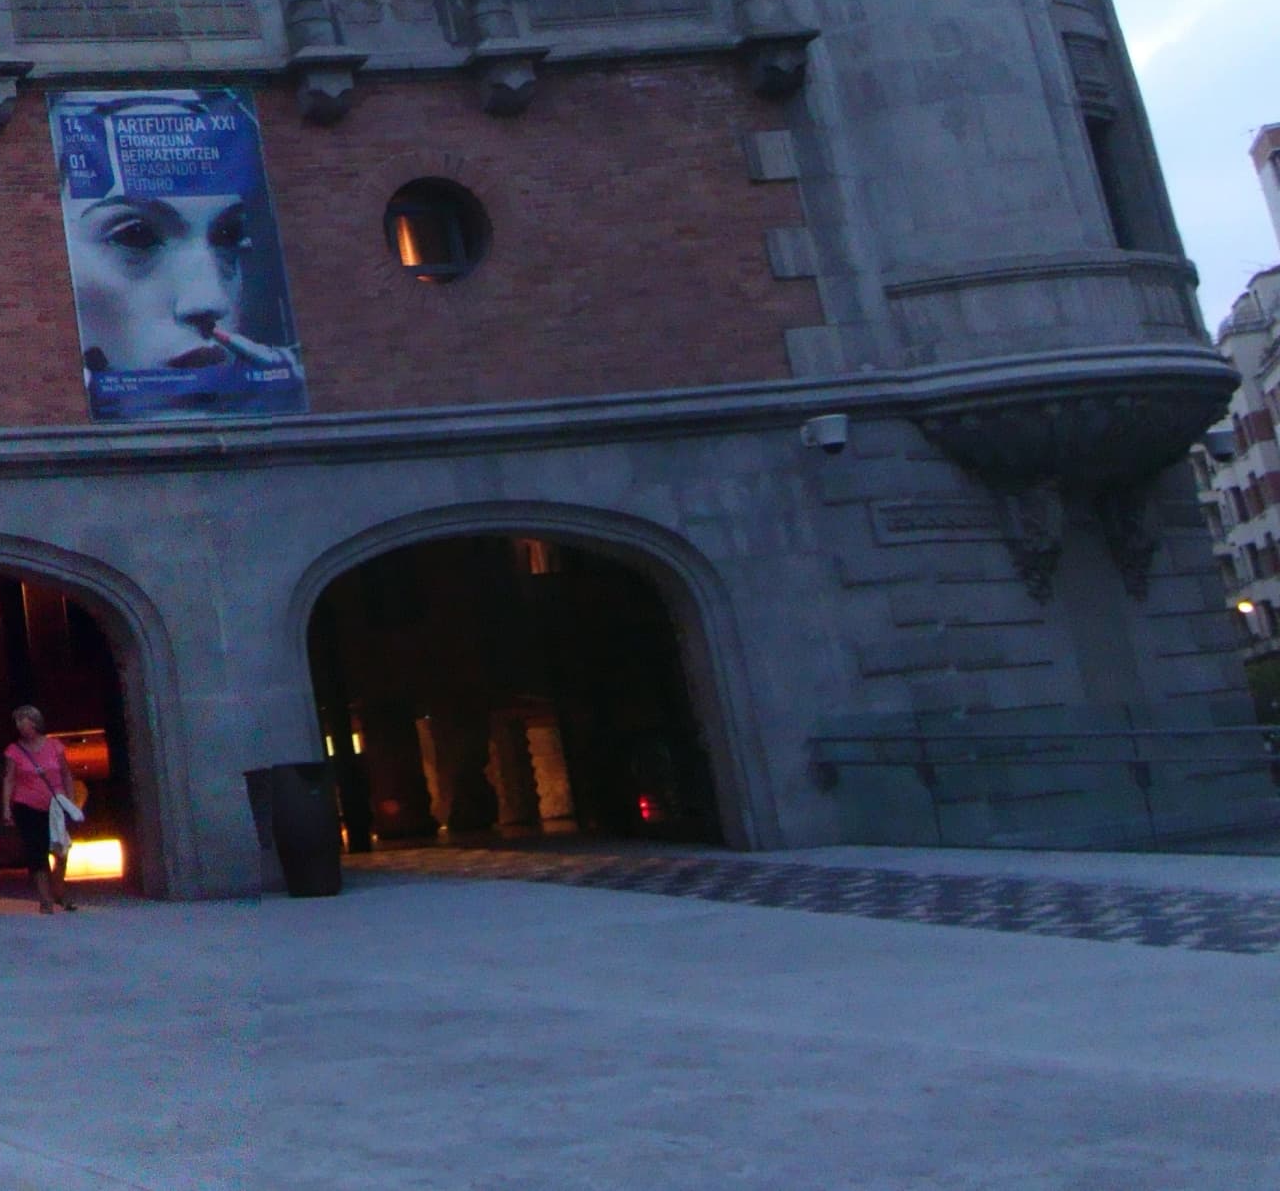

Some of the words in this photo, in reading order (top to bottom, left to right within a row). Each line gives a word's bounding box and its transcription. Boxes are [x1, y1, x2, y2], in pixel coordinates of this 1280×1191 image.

[65, 118, 82, 132] 14
[118, 117, 206, 133] ARTFUTURA
[210, 115, 236, 131] XXI
[120, 134, 194, 147] ETORKIZUNA
[70, 154, 86, 169] 01
[123, 161, 197, 176] REPASANDO
[201, 161, 216, 174] EL
[127, 176, 174, 191] FUTURO
